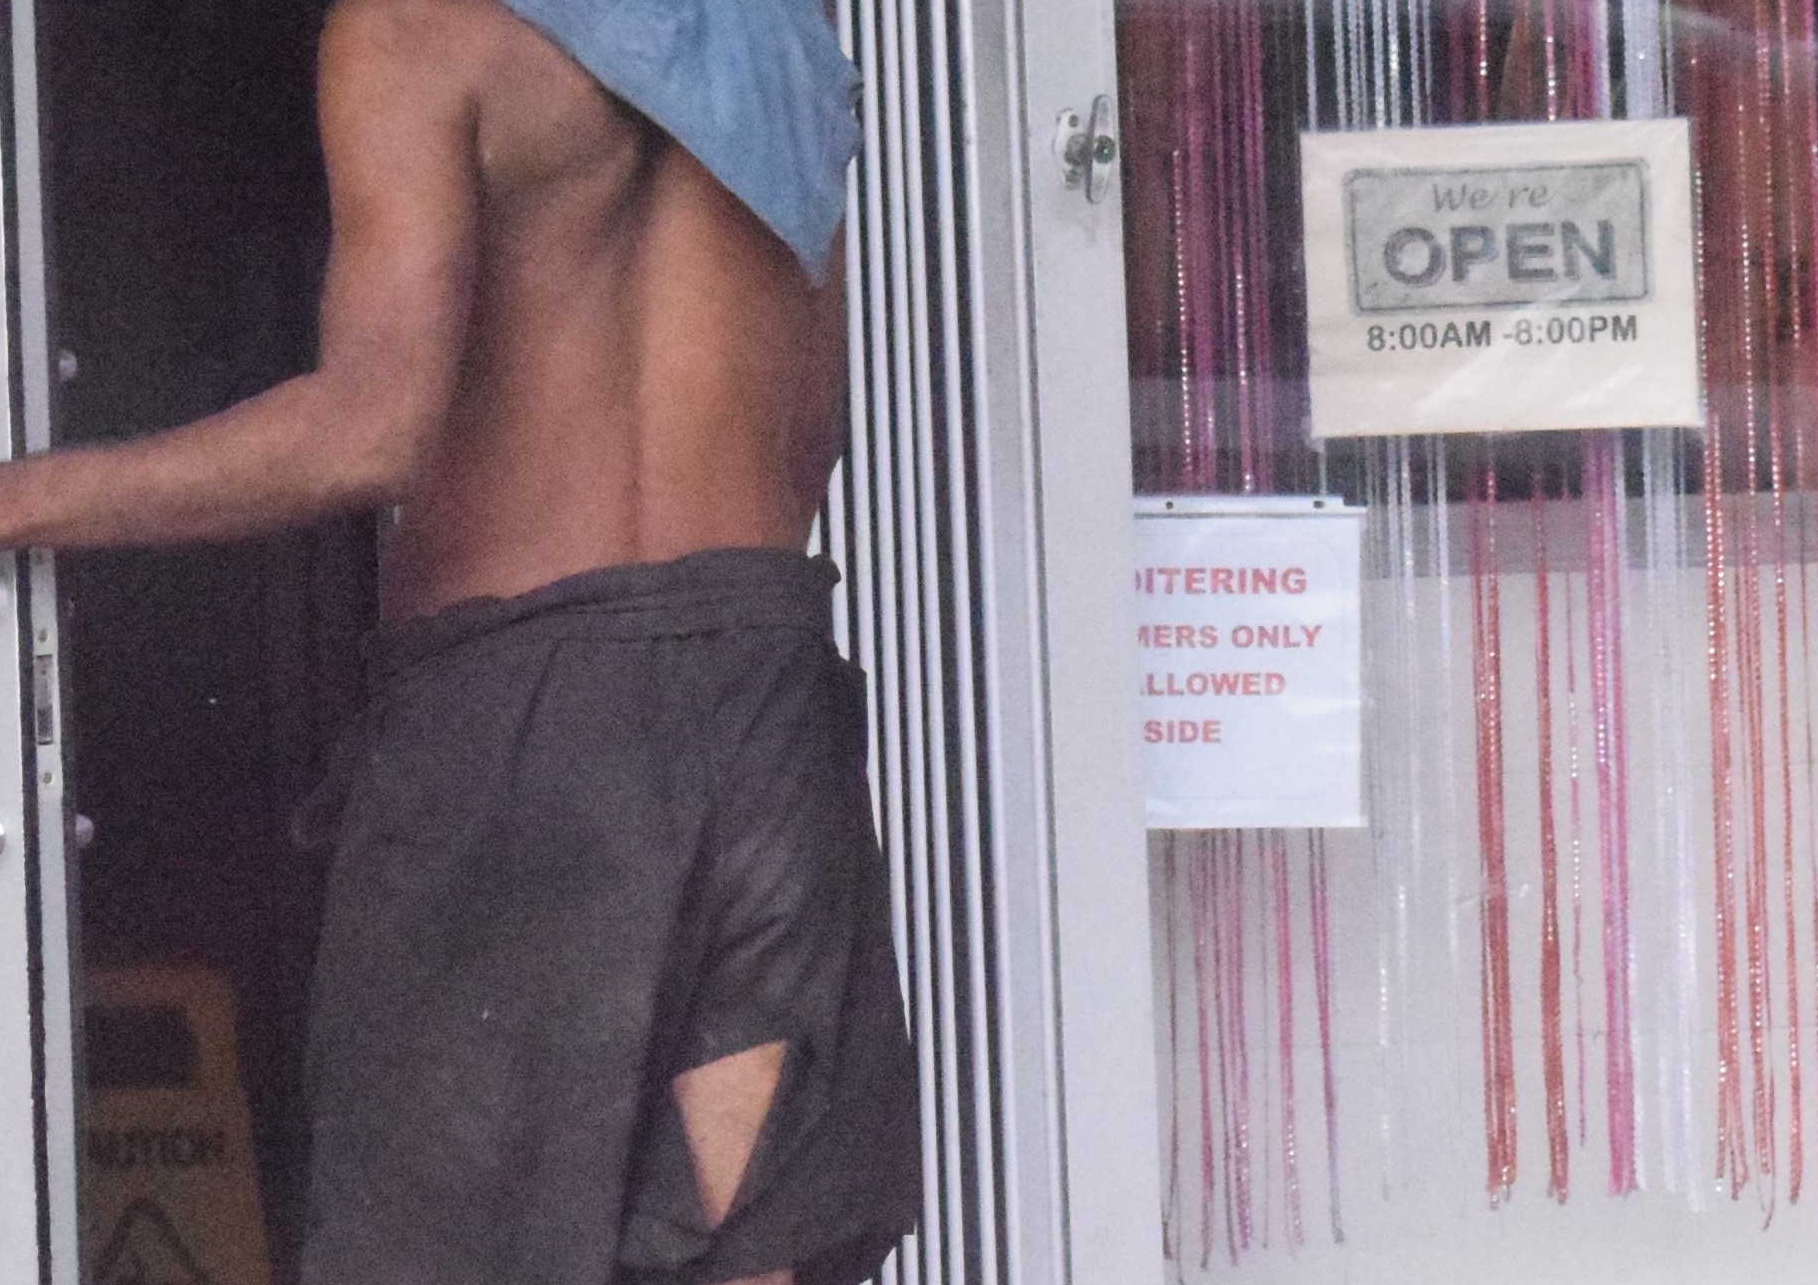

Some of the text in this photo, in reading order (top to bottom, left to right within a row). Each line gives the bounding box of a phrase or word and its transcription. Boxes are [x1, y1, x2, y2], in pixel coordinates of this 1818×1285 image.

[1432, 181, 1556, 212] Were
[1384, 219, 1617, 288] OPEN
[1366, 320, 1491, 352] 8:00AM
[1135, 567, 1308, 595] ITERING
[1231, 624, 1323, 649] ONLY
[1140, 672, 1287, 697] LLOWED
